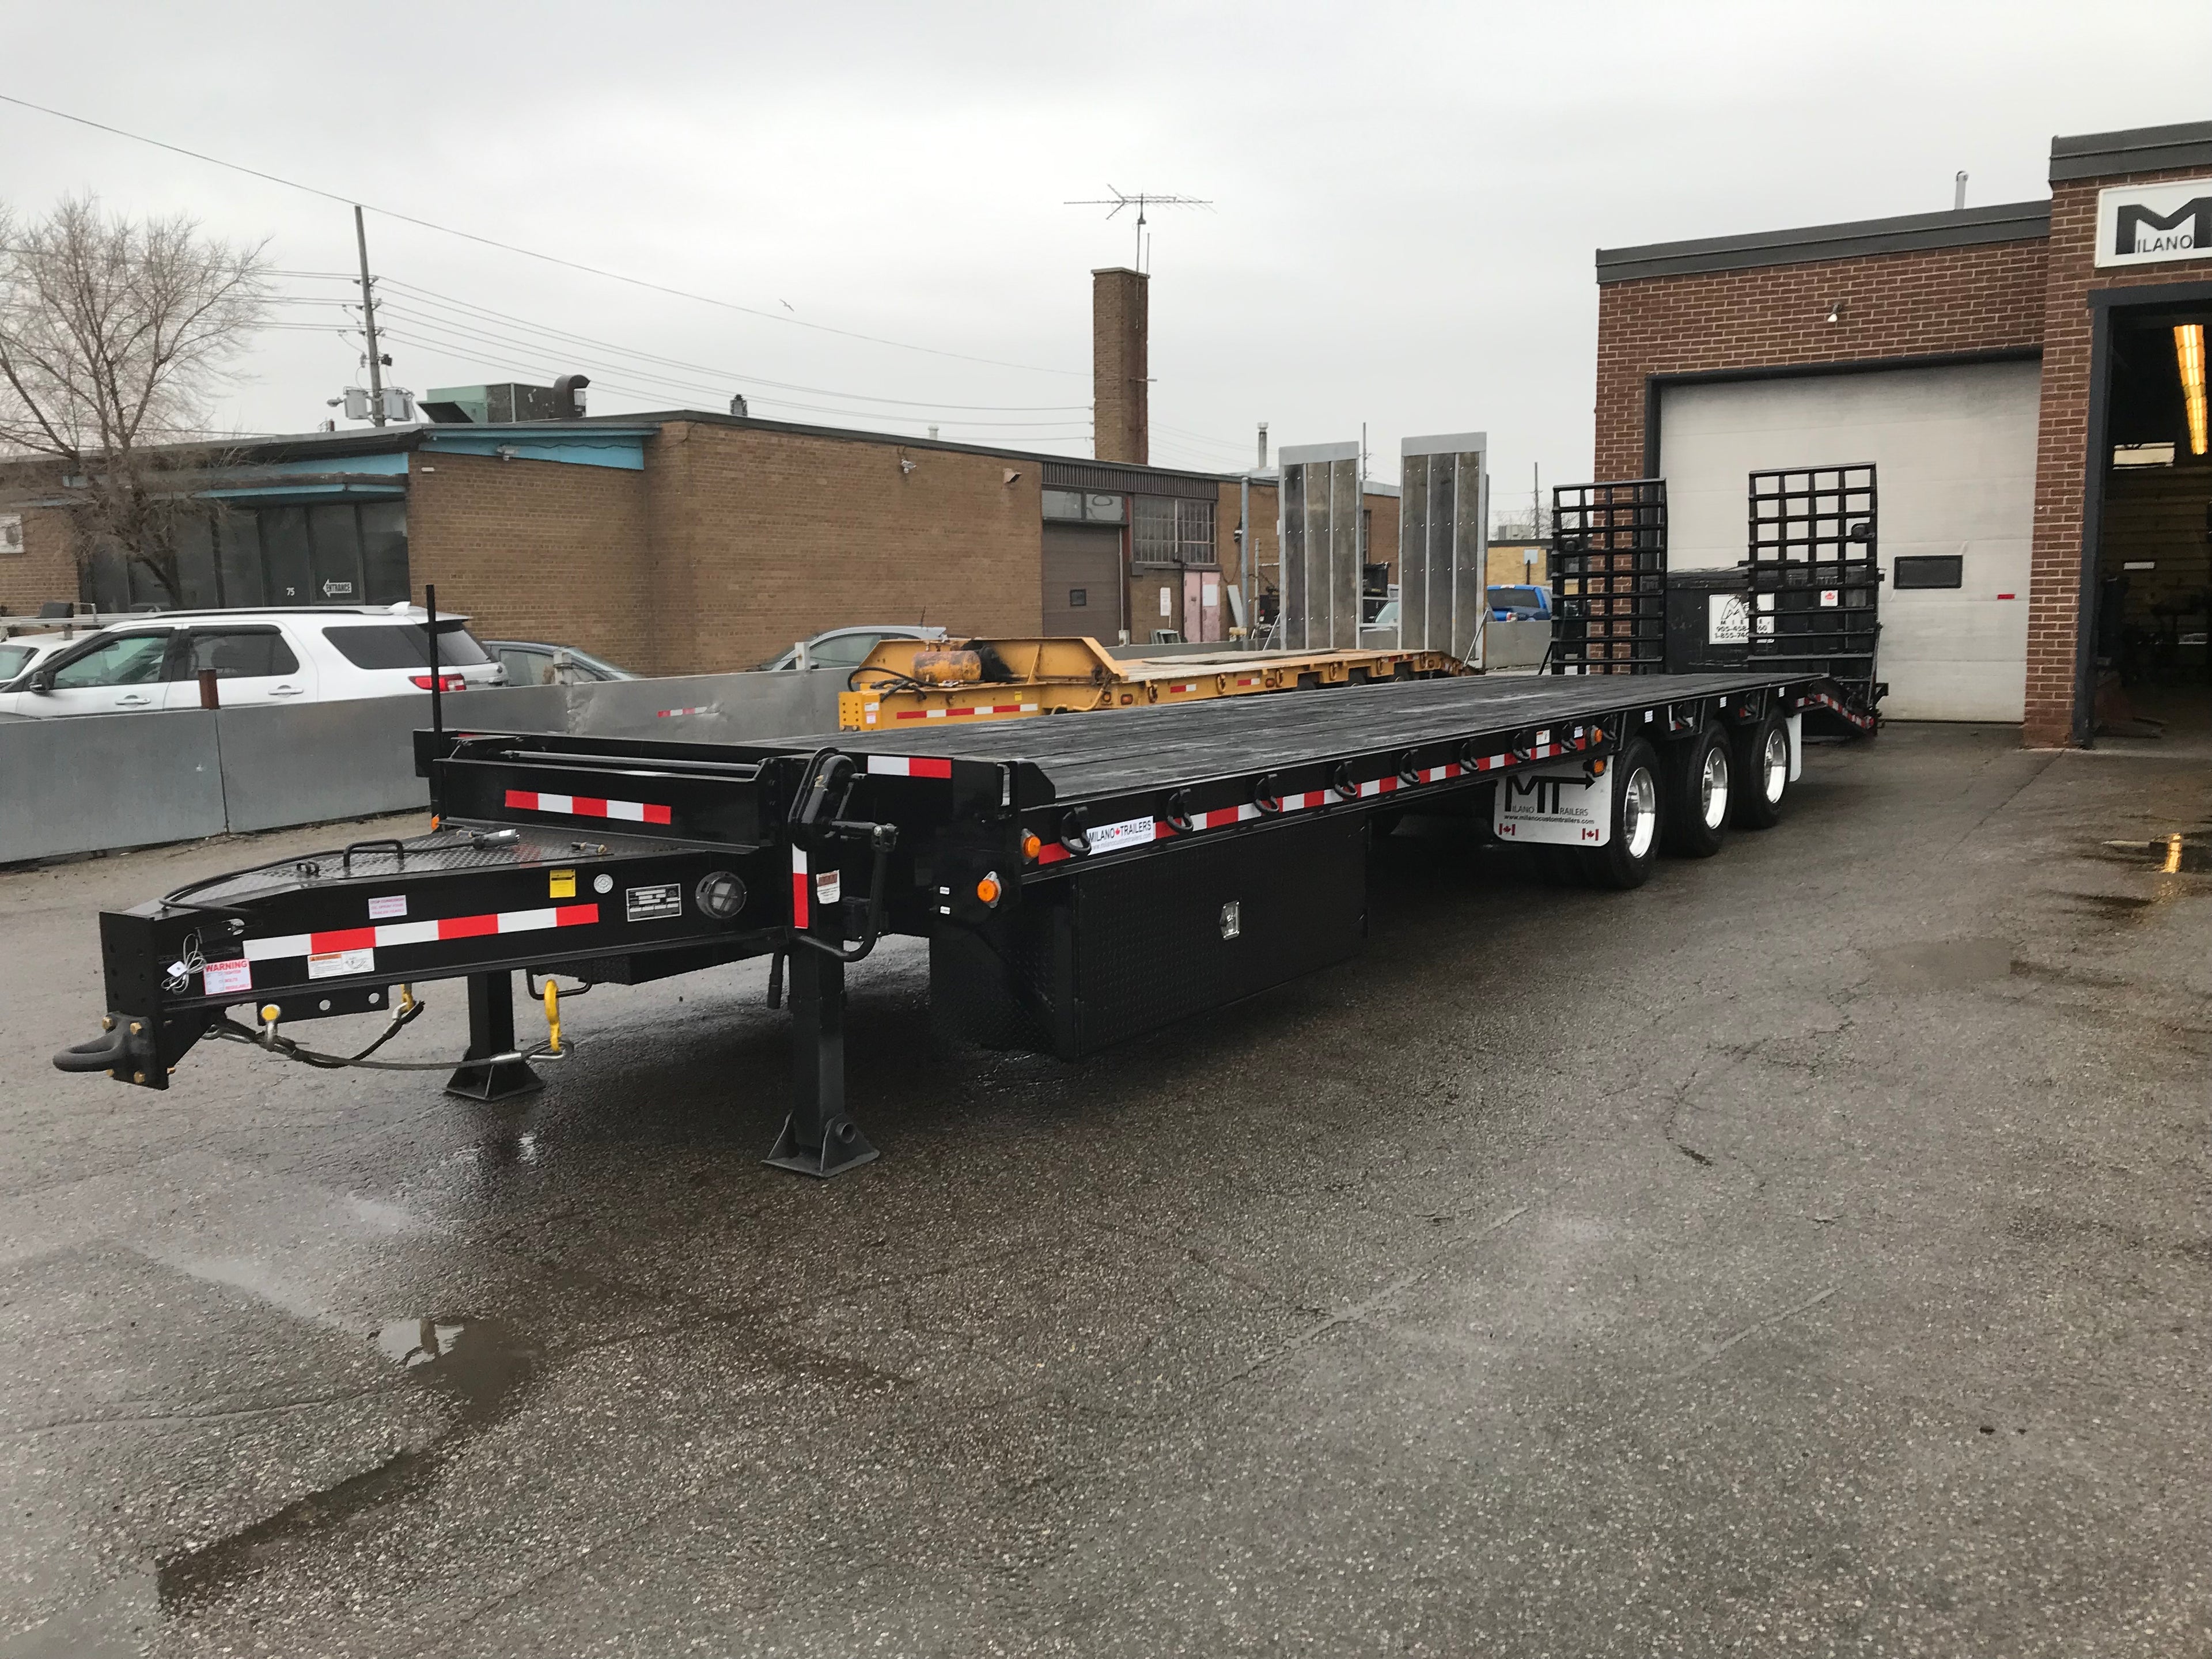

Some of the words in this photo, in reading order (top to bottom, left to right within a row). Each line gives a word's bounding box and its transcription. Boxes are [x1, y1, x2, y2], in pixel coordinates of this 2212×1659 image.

[286, 587, 295, 596] 75
[1088, 828, 1116, 843] MILANO
[1120, 820, 1152, 836] TRAILERS
[206, 960, 247, 972] WARNING
